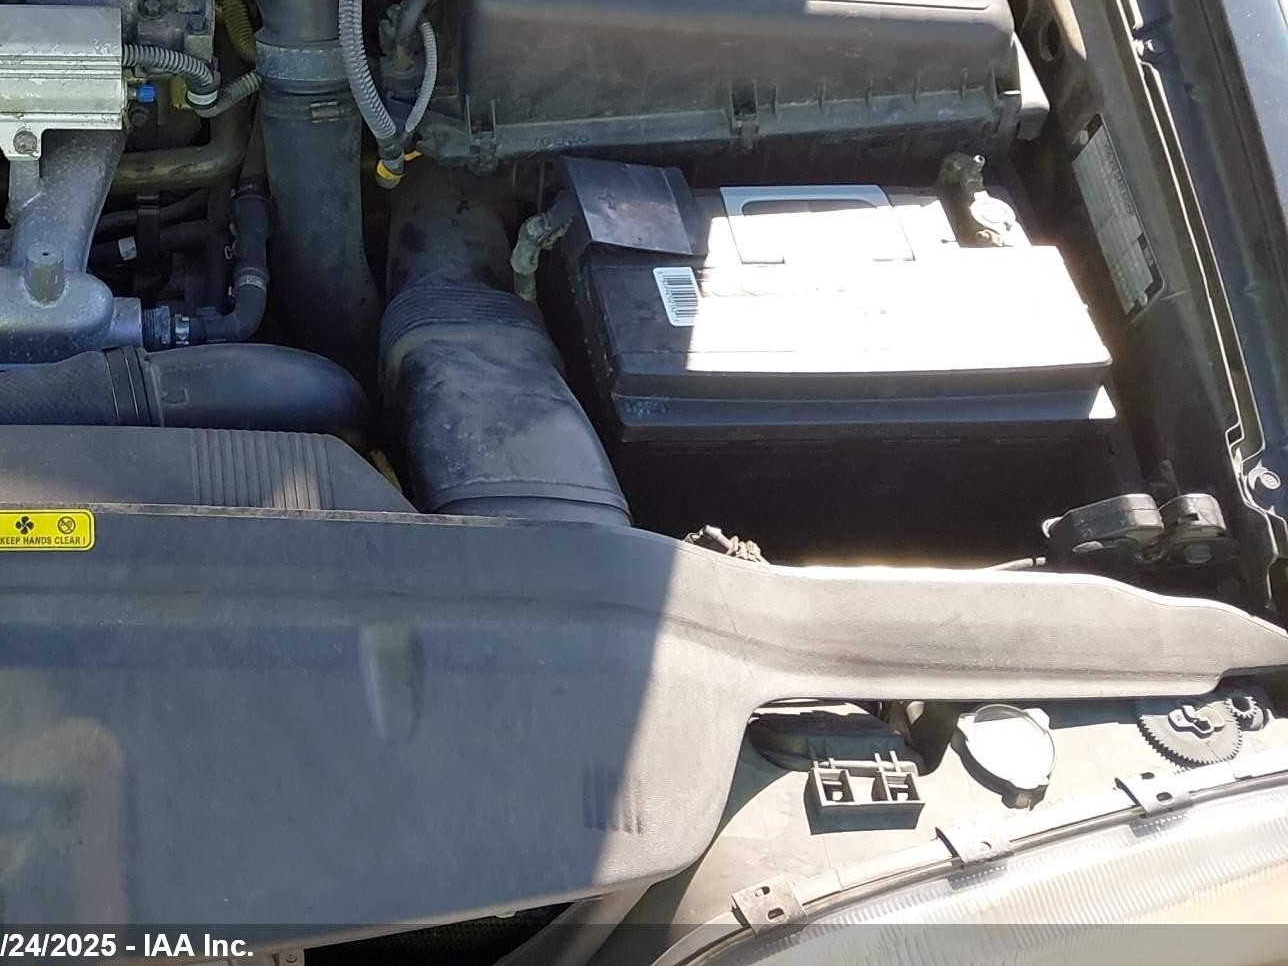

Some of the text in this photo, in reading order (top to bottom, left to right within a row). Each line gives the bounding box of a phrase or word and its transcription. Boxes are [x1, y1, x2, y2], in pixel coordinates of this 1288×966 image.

[0, 536, 20, 545] KEEP
[23, 536, 52, 545] HANDS
[54, 536, 80, 545] CLEAR
